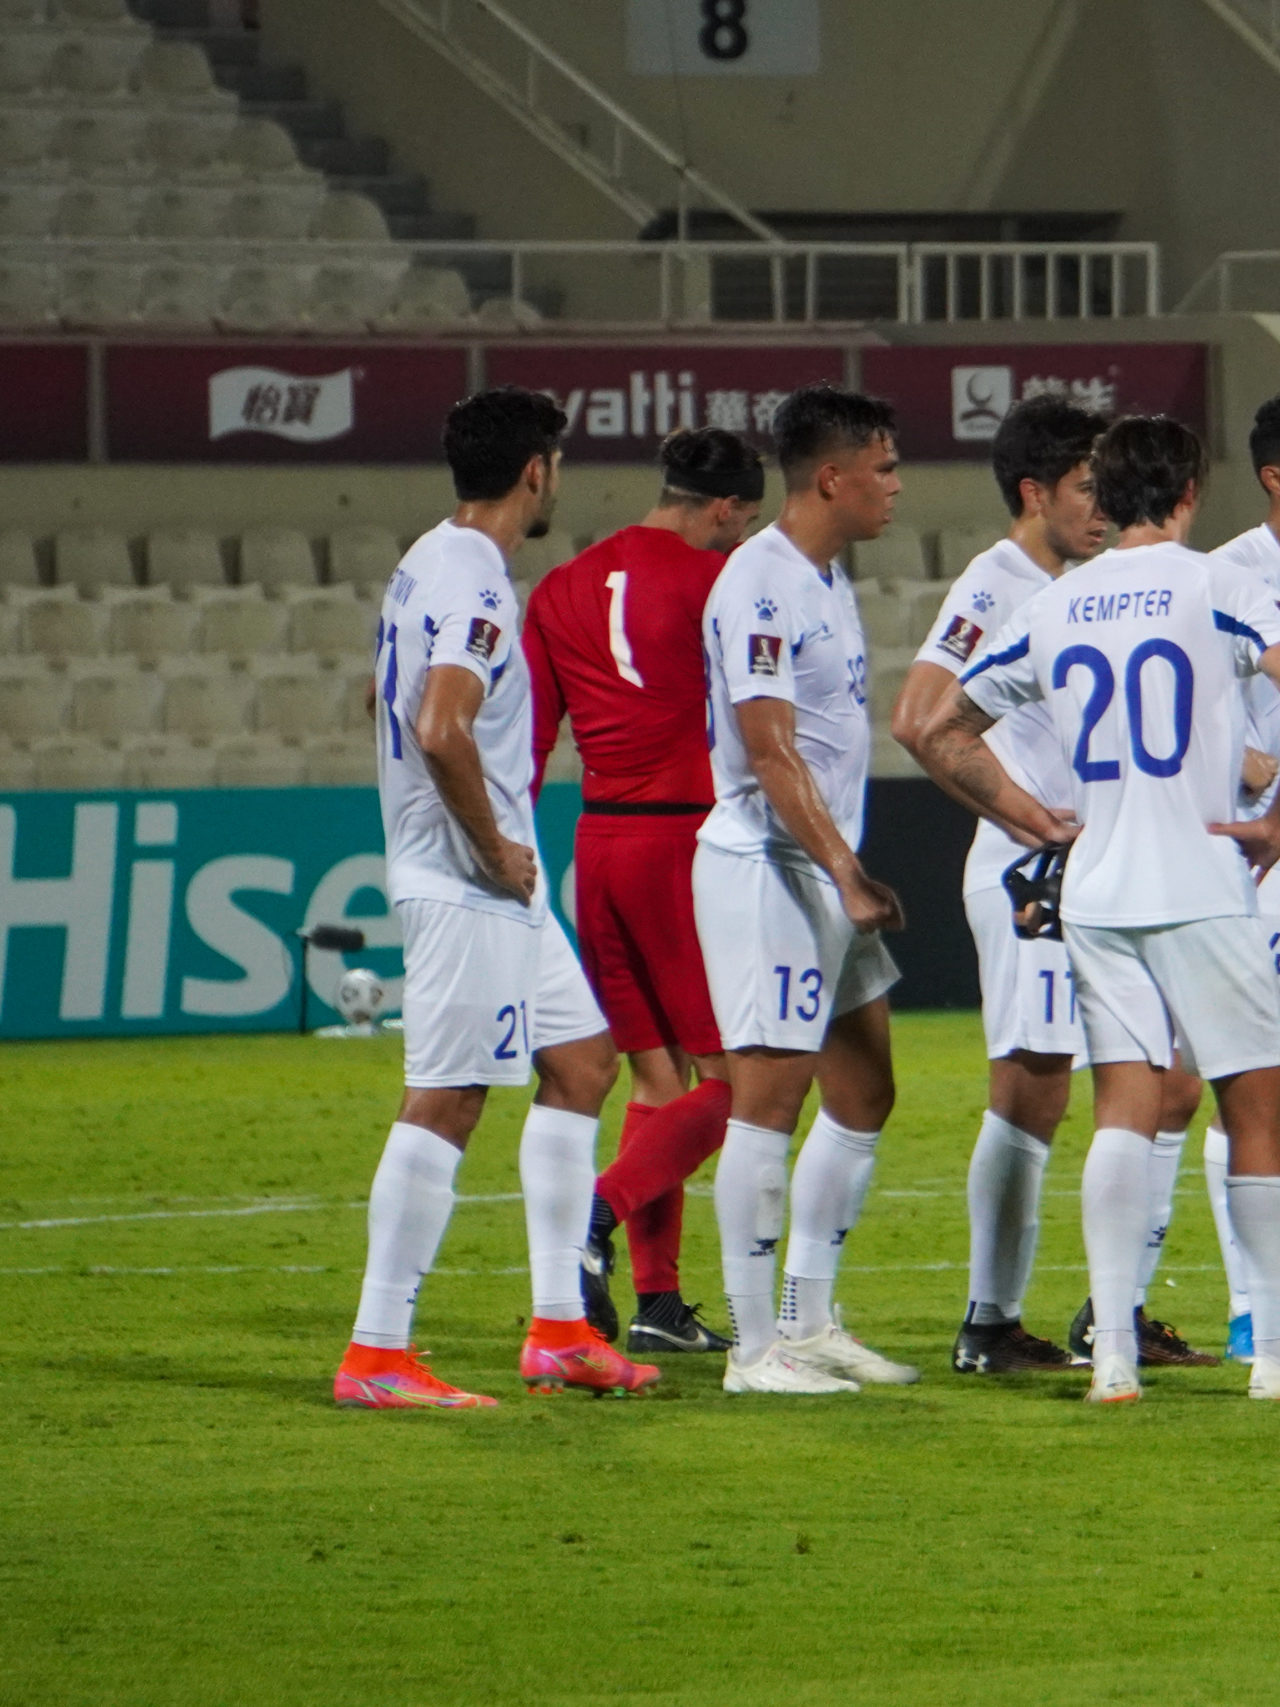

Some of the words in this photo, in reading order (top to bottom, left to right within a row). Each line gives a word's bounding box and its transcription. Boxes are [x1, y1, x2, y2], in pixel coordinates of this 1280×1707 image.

[699, 0, 748, 60] 8
[604, 570, 645, 688] 1
[1067, 589, 1173, 624] KEMPTER
[1052, 637, 1194, 783] 20
[773, 965, 823, 1022] 13
[494, 1000, 529, 1060] 21
